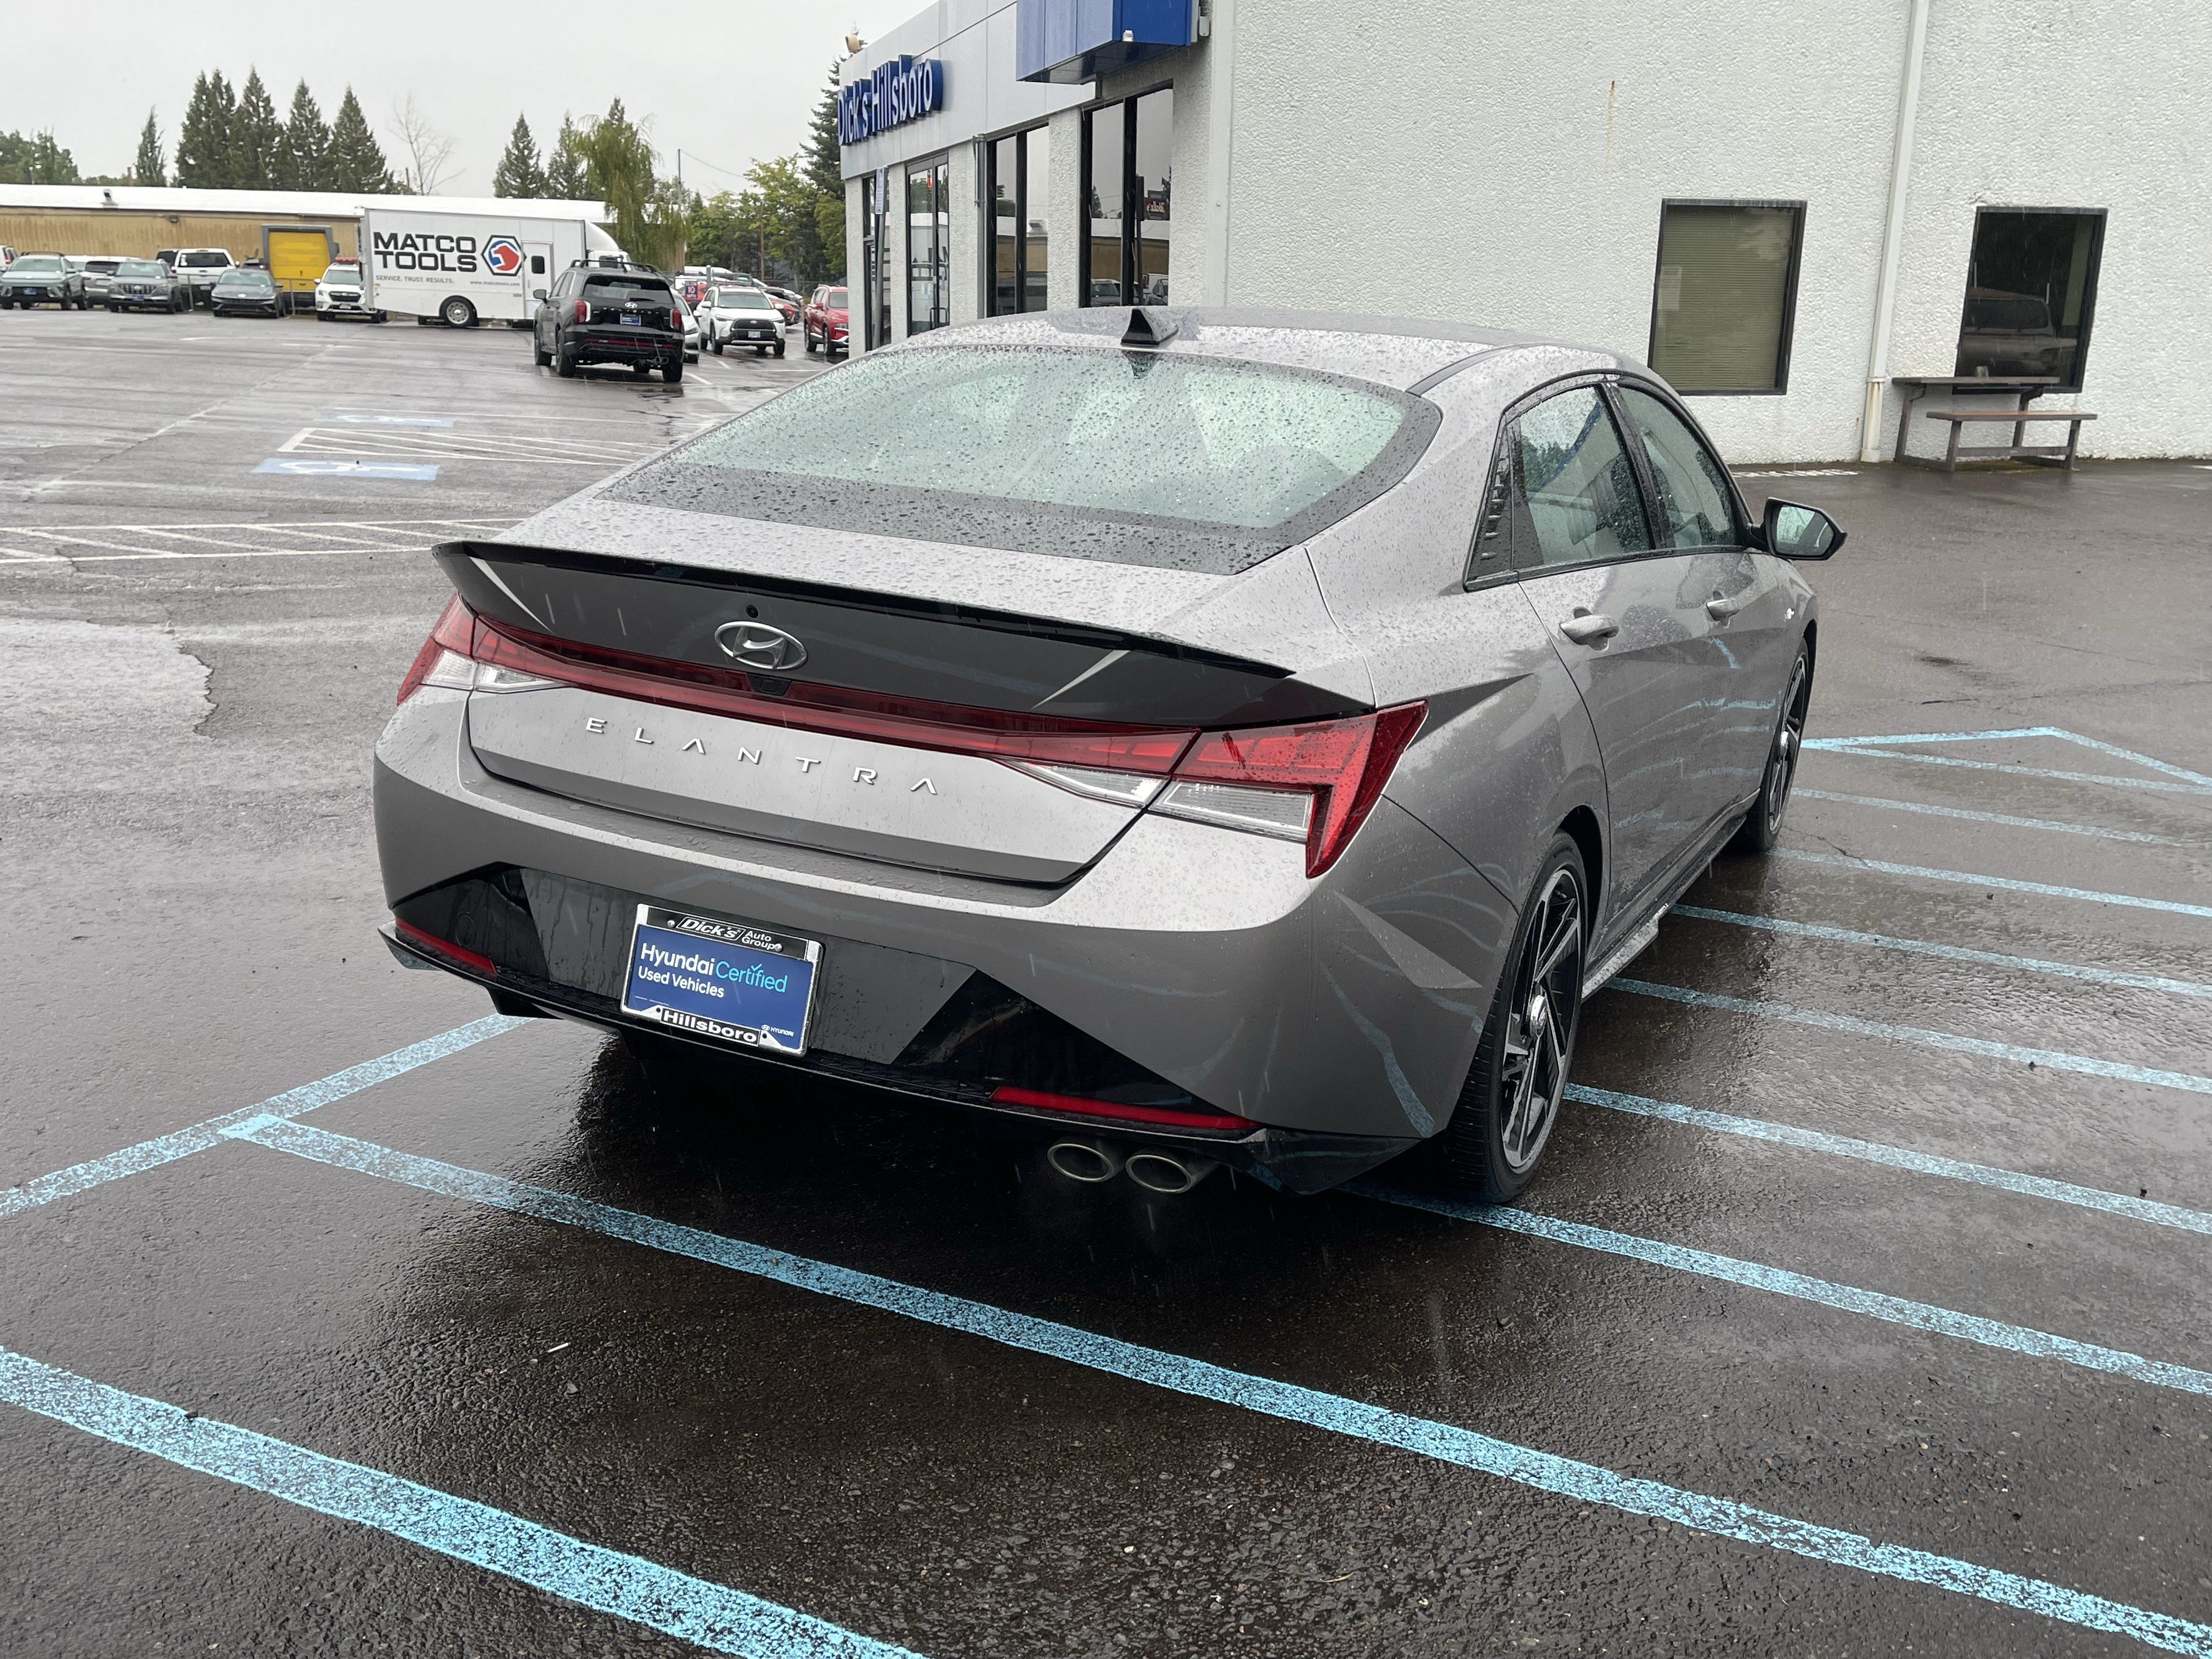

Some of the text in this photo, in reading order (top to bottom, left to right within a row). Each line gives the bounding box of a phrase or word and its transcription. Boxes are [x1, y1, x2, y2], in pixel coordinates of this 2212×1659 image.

[838, 54, 934, 146] Dick's Hillsboro
[374, 232, 476, 253] MATCO
[374, 250, 477, 273] TOOLS
[586, 717, 937, 795] ELANTRA
[681, 919, 737, 939] Dick's
[745, 930, 772, 942] Auto
[742, 937, 775, 951] Group
[641, 943, 788, 993] Hyundai Certified
[638, 966, 725, 998] Used Vehicles
[663, 1009, 757, 1043] Hillsboro
[770, 1026, 794, 1037] HYUNDAI
